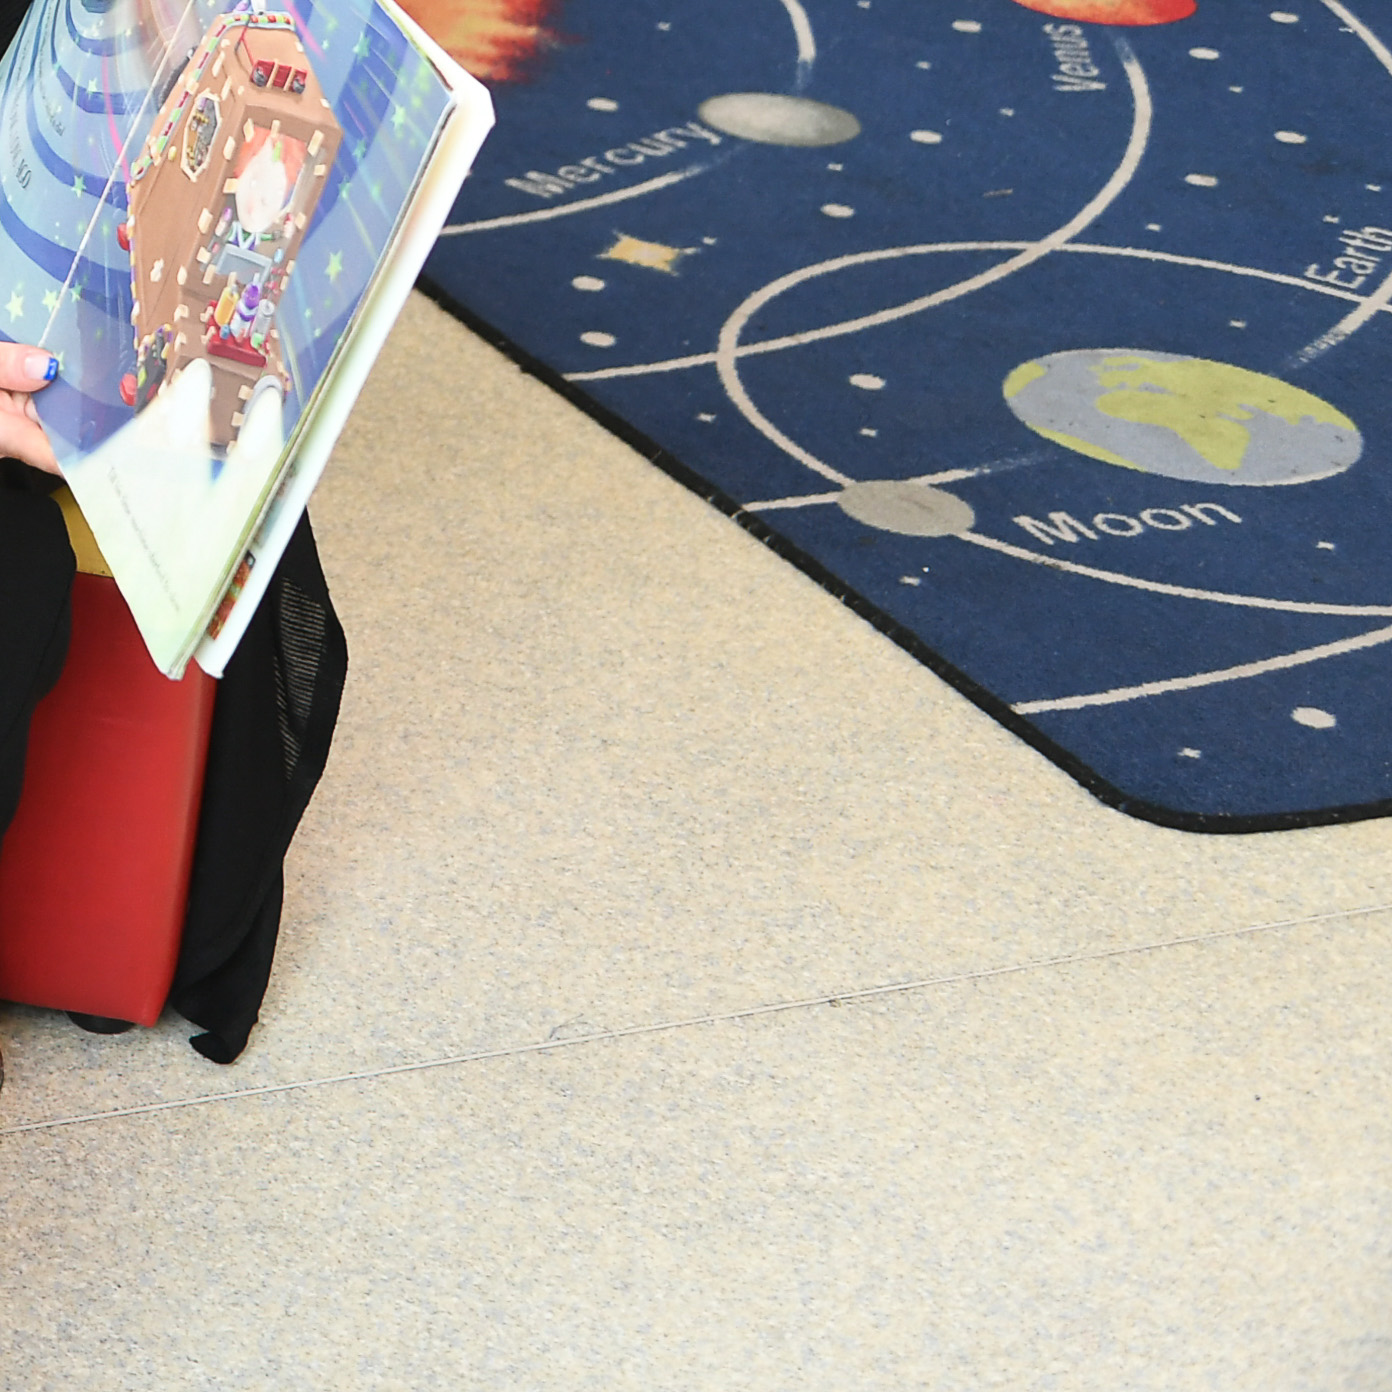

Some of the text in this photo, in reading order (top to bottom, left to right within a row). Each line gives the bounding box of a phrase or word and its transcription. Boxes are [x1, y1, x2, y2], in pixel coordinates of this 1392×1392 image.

[1042, 22, 1107, 92] Venus
[504, 120, 723, 199] Mercury
[1303, 226, 1392, 289] Earth
[1013, 500, 1243, 546] Moon
